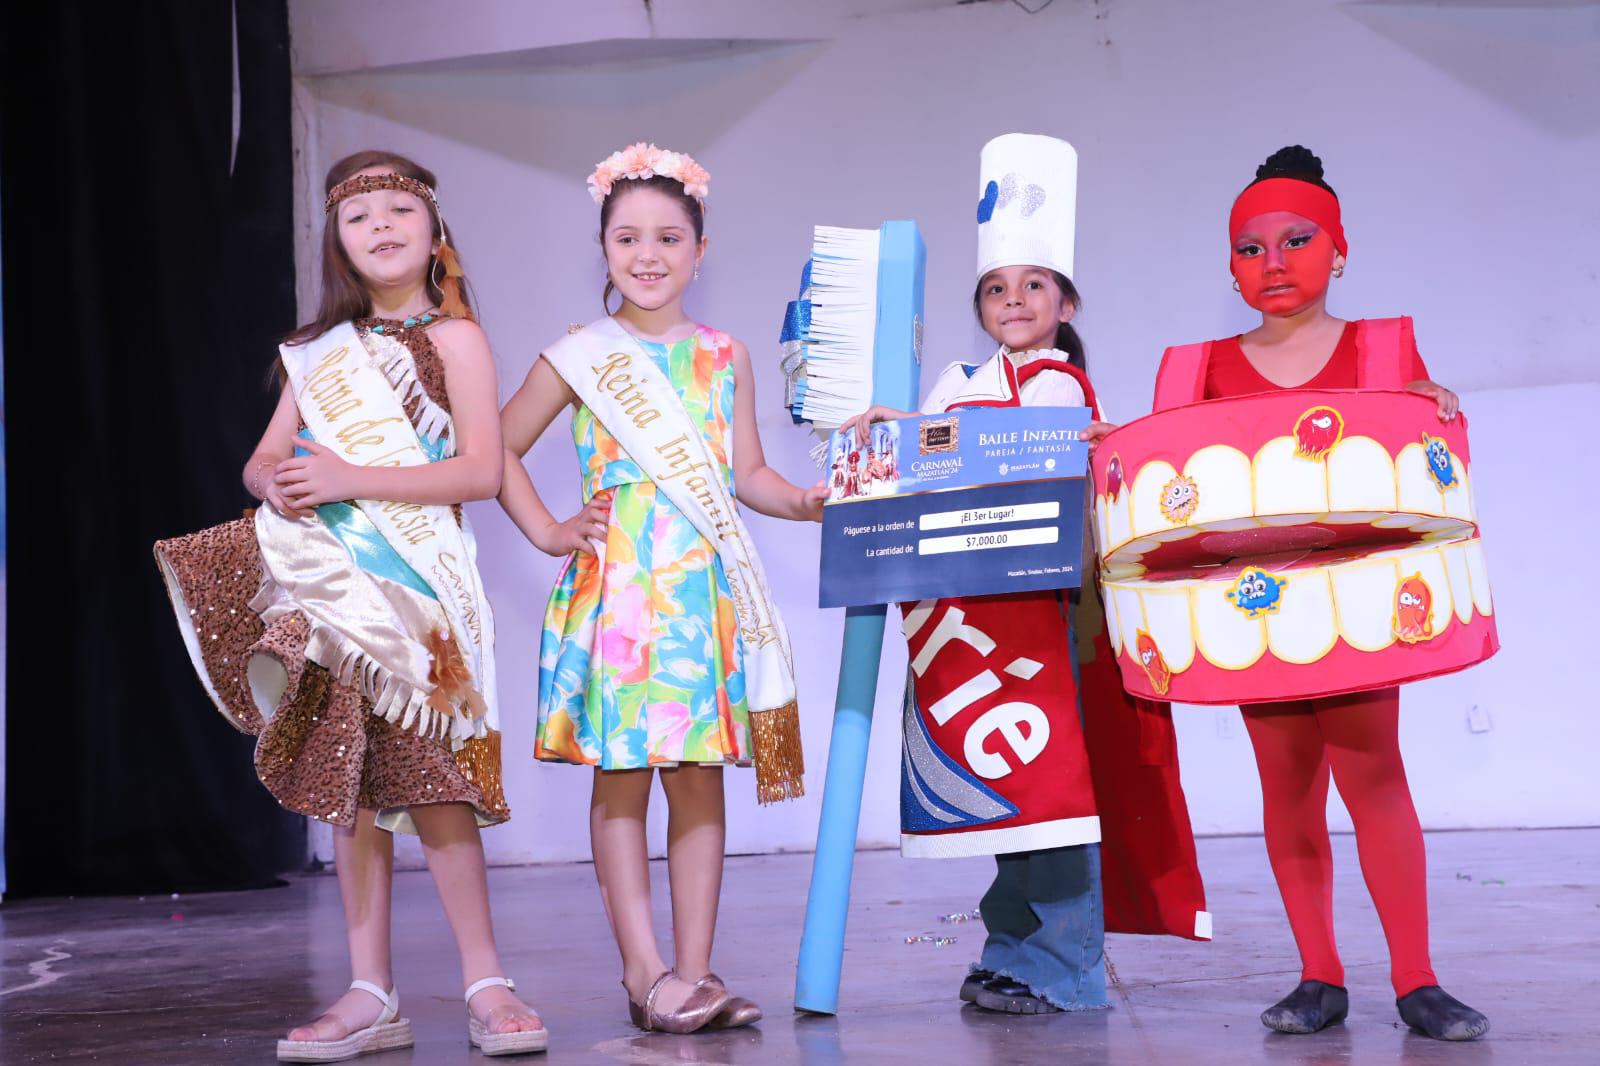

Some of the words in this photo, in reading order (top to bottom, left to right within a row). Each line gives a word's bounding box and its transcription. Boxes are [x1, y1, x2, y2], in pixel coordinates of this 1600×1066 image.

[299, 346, 364, 423] Reina
[335, 417, 404, 456] de
[978, 432, 1018, 446] BAILE
[1022, 429, 1081, 442] INFATIL
[591, 351, 662, 430] Reina
[654, 432, 740, 541] Infantil
[984, 447, 1016, 458] PAREJA
[1026, 443, 1072, 454] FANTASÍA
[911, 456, 965, 472] CARNAVAL
[961, 512, 971, 524] ¡El
[973, 511, 987, 521] 3er
[988, 508, 1014, 521] Lugar!
[843, 525, 871, 537] Páguese
[871, 525, 877, 533] a
[877, 523, 885, 532] la
[885, 521, 905, 531] orden
[905, 519, 915, 529] de
[966, 534, 1008, 548] $7,000.00
[866, 548, 875, 557] La
[875, 545, 904, 557] cantidad
[904, 544, 914, 553] de
